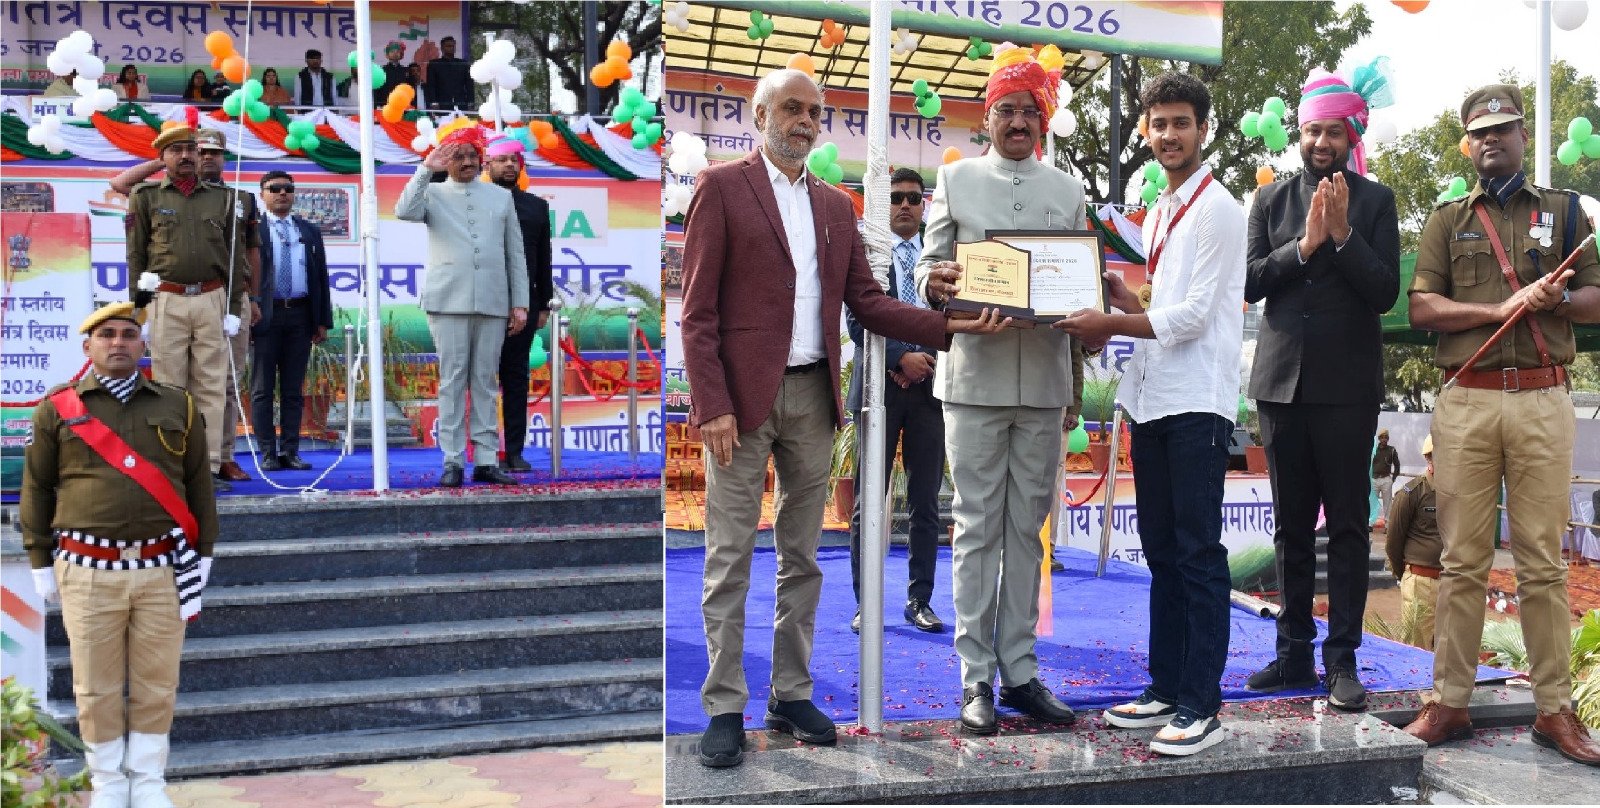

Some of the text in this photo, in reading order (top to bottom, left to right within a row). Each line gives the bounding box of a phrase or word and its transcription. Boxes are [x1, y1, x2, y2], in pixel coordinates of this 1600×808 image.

[1019, 1, 1121, 35] 2026
[121, 44, 184, 63] 2026
[27, 319, 69, 342] दिवस
[1, 379, 45, 394] 2026
